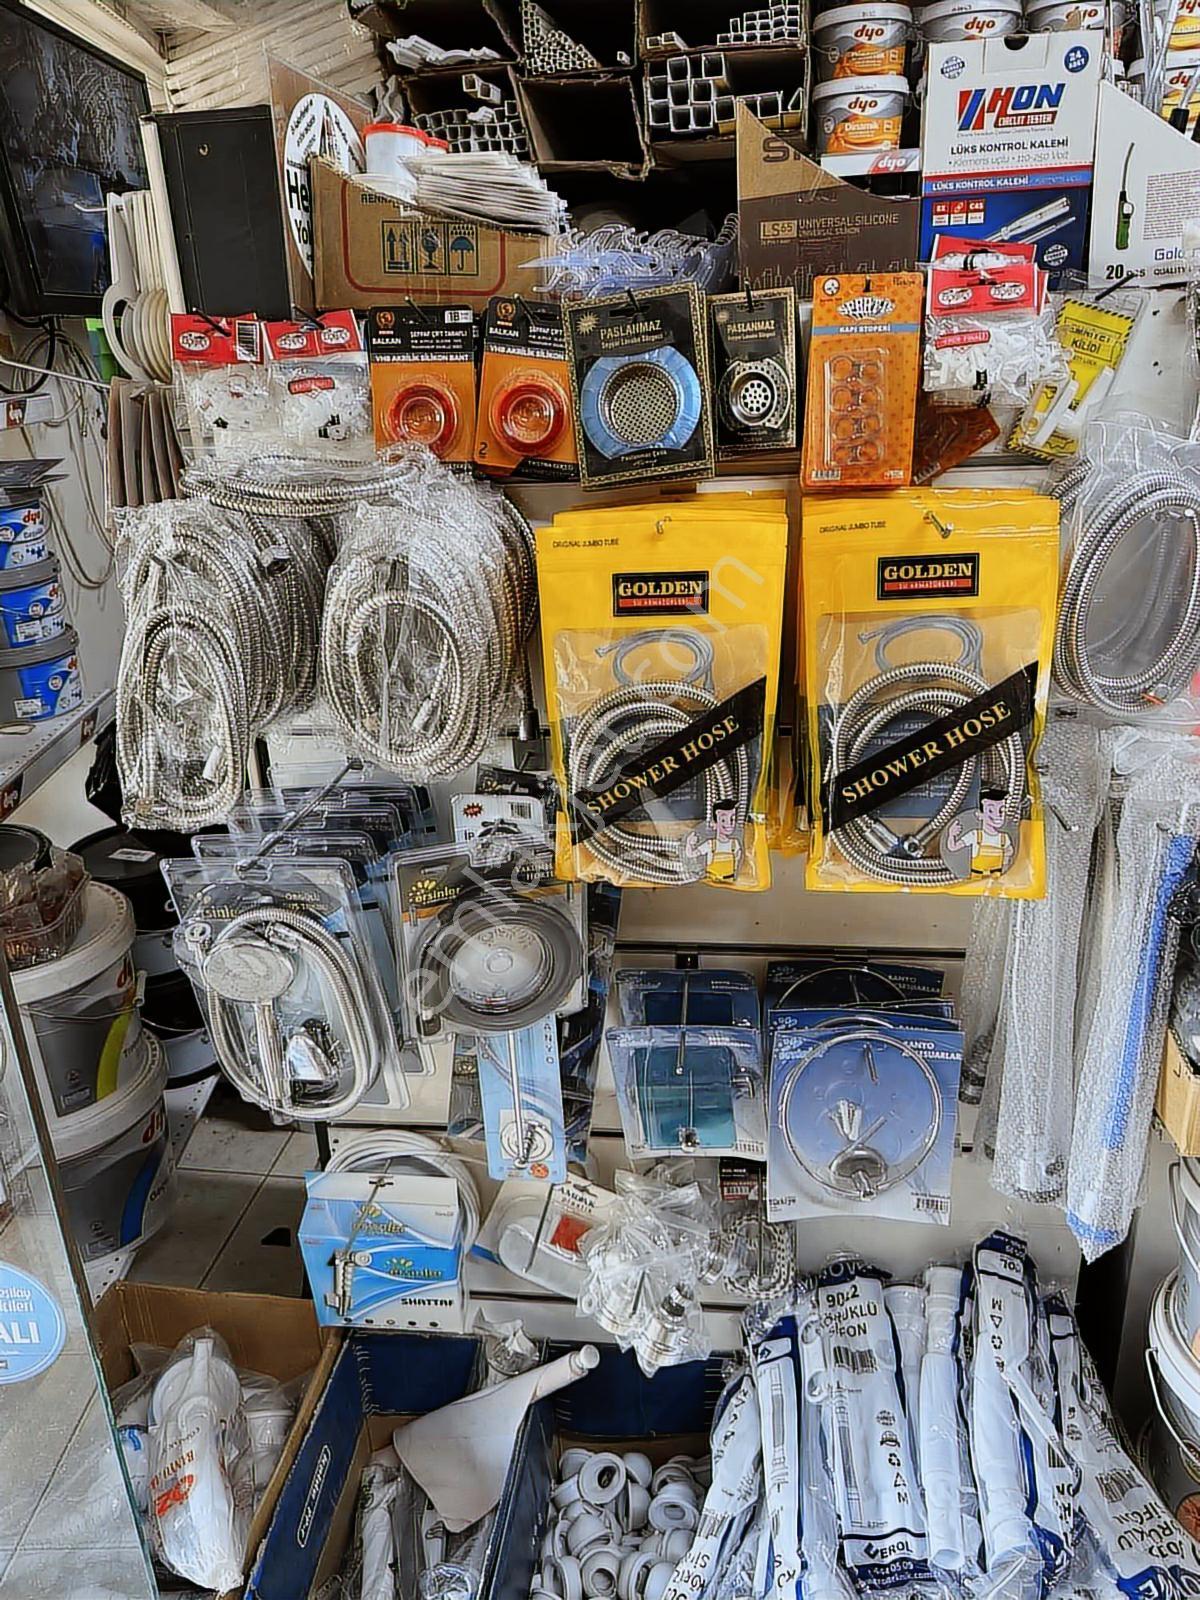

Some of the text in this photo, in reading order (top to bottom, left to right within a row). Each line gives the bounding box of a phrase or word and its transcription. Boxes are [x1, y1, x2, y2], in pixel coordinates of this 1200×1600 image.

[964, 15, 996, 33] dyo
[854, 25, 885, 41] dyo
[847, 97, 878, 113] dyo
[951, 135, 1069, 155] LÜKS KONTROL KALEMİ
[878, 156, 907, 170] dyo
[932, 181, 955, 192] LÜKS
[955, 178, 996, 189] KONTROL
[996, 175, 1029, 187] KALEMİ
[1105, 264, 1124, 280] 20
[1153, 266, 1186, 276] QUALITY
[448, 312, 460, 322] 18
[489, 327, 519, 338] BALKAN
[600, 319, 662, 340] PASLANMAZ
[727, 320, 775, 335] PASLANMAZ
[372, 337, 402, 345] BALKAN
[374, 354, 391, 362] VHB
[479, 443, 487, 455] 2
[884, 562, 974, 580] GOLDEN
[618, 580, 704, 597] GOLDEN
[841, 700, 1012, 803] SHOWER HOSE
[586, 714, 740, 816] SHOWER HOSE
[880, 1540, 914, 1560] EROL
